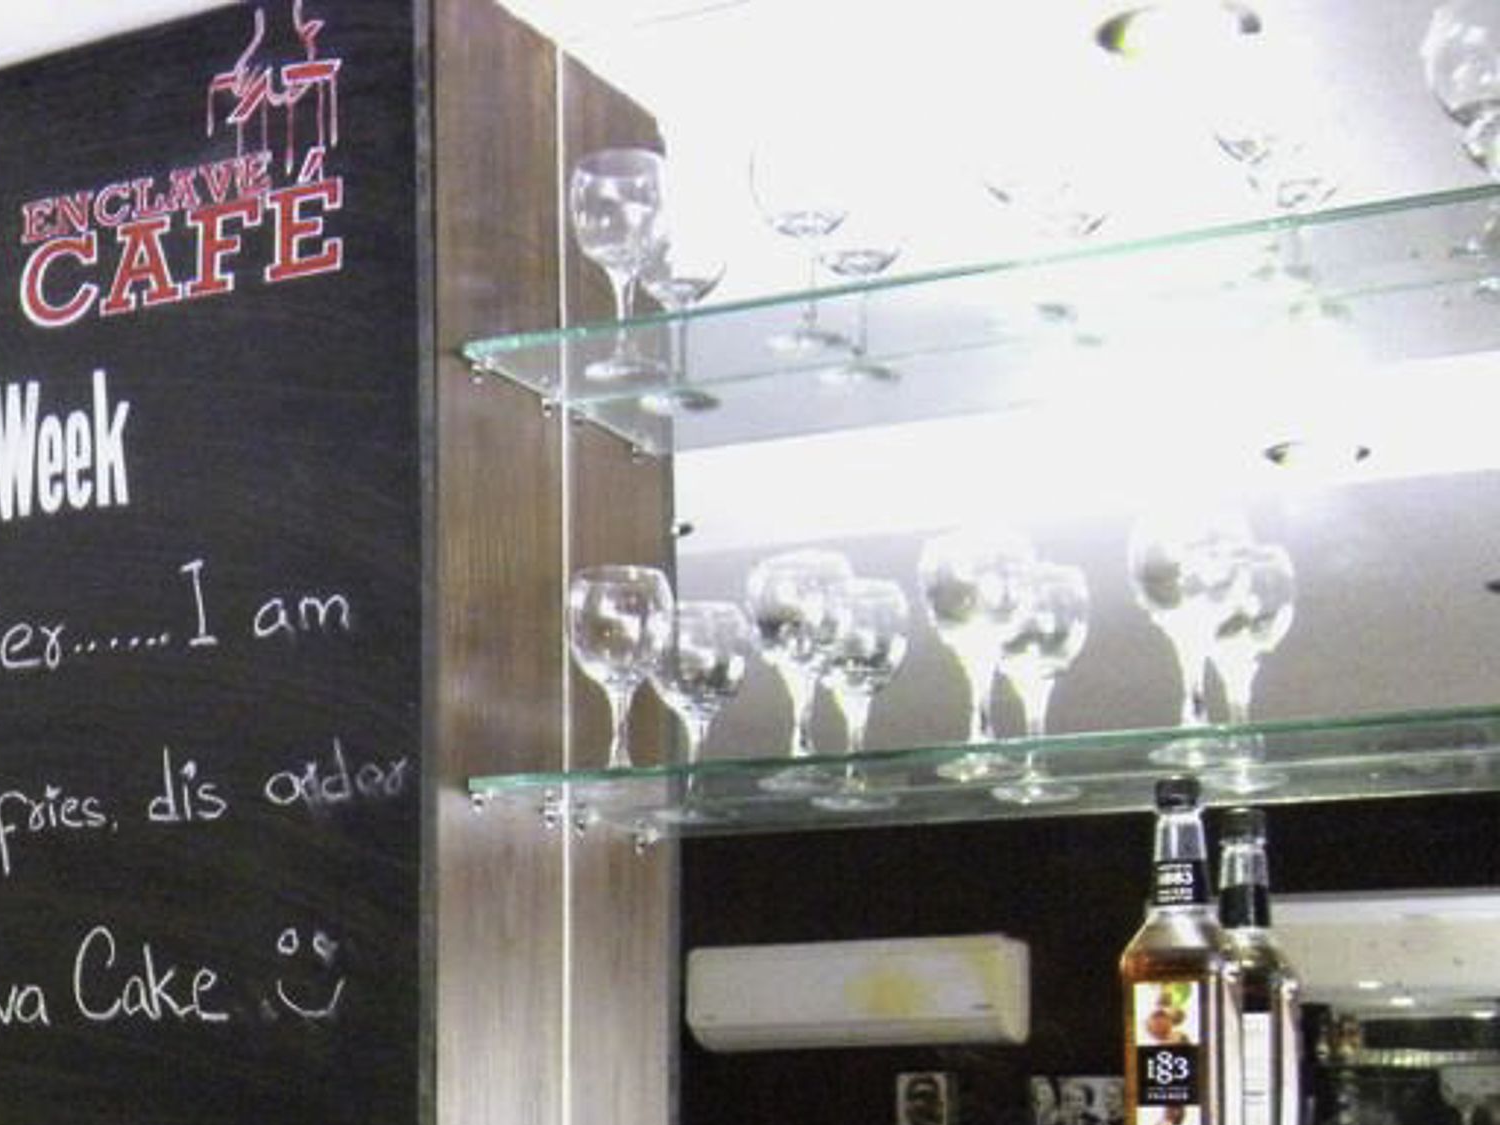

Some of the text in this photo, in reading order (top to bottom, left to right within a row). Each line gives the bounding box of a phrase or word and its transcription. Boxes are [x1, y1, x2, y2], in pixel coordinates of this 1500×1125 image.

[21, 150, 273, 244] ENCLAVE
[180, 558, 218, 646] I
[253, 593, 351, 637] am
[147, 744, 228, 823] dis
[72, 925, 230, 1022] Cake
